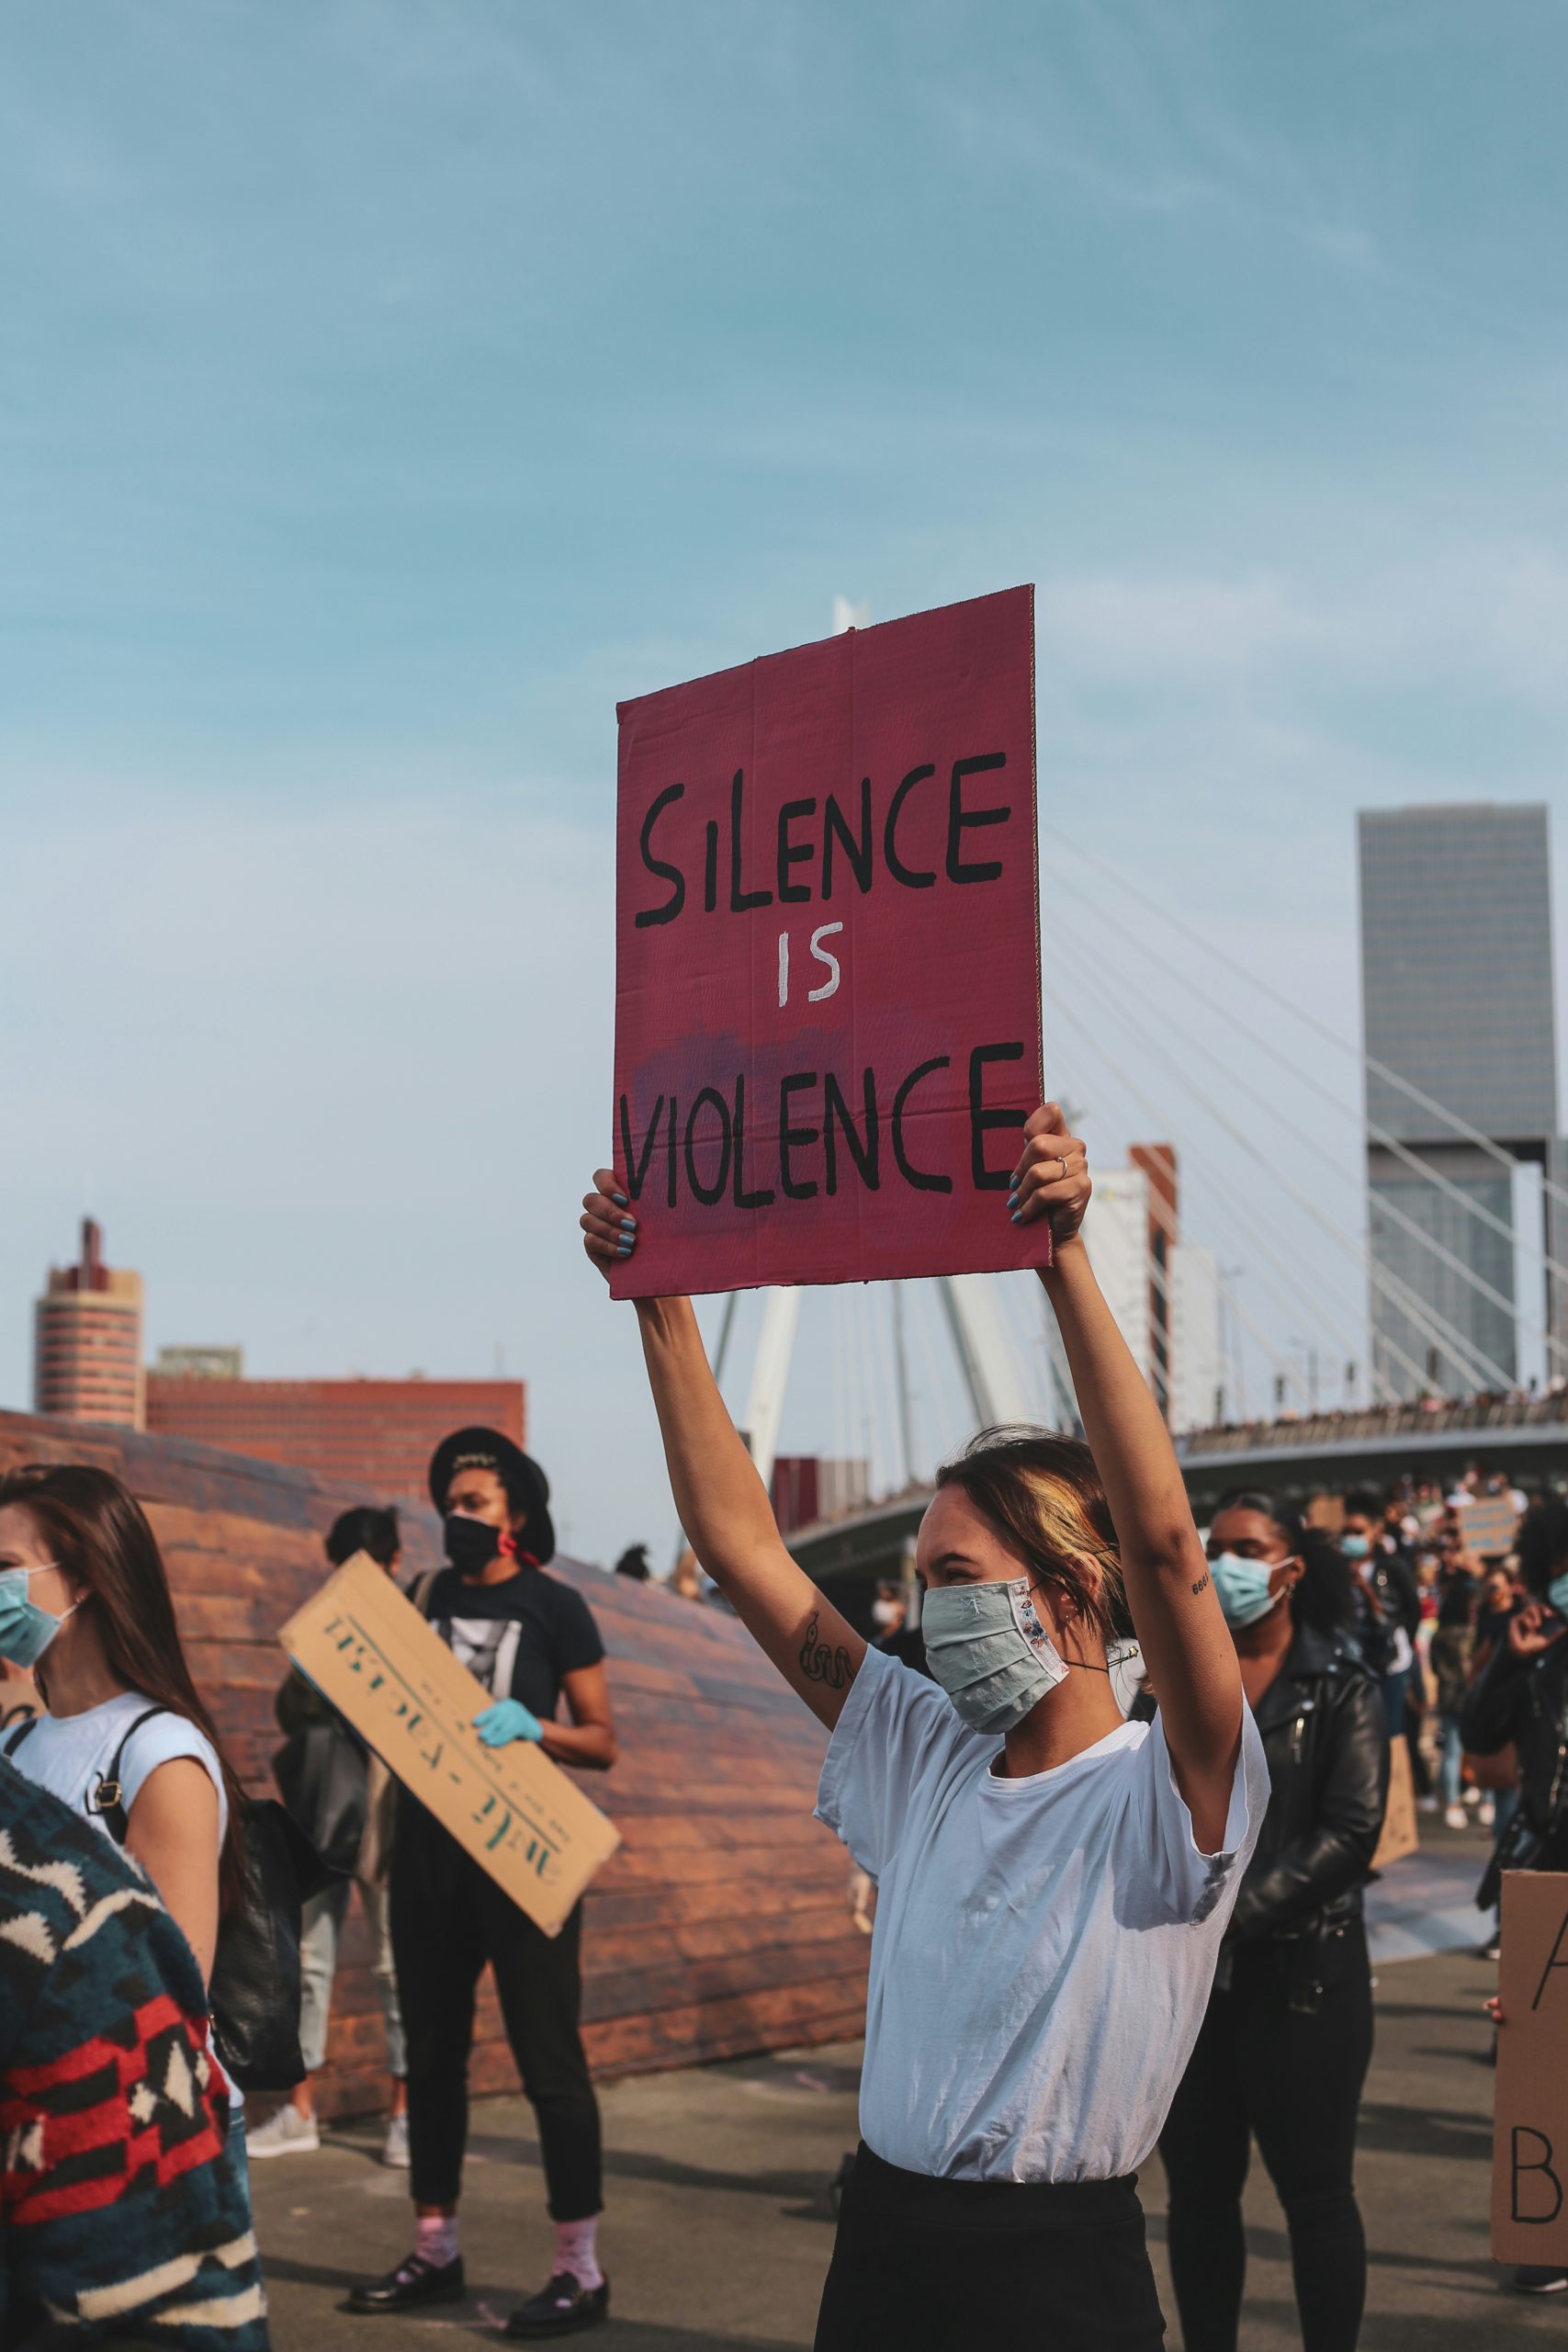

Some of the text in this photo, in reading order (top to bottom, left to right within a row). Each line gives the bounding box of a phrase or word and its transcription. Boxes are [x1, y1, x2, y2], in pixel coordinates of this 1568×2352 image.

[635, 752, 1010, 928] SILENCE
[778, 922, 844, 1007] IS
[620, 1042, 1028, 1209] VIOLENCE
[1512, 2126, 1563, 2224] B
